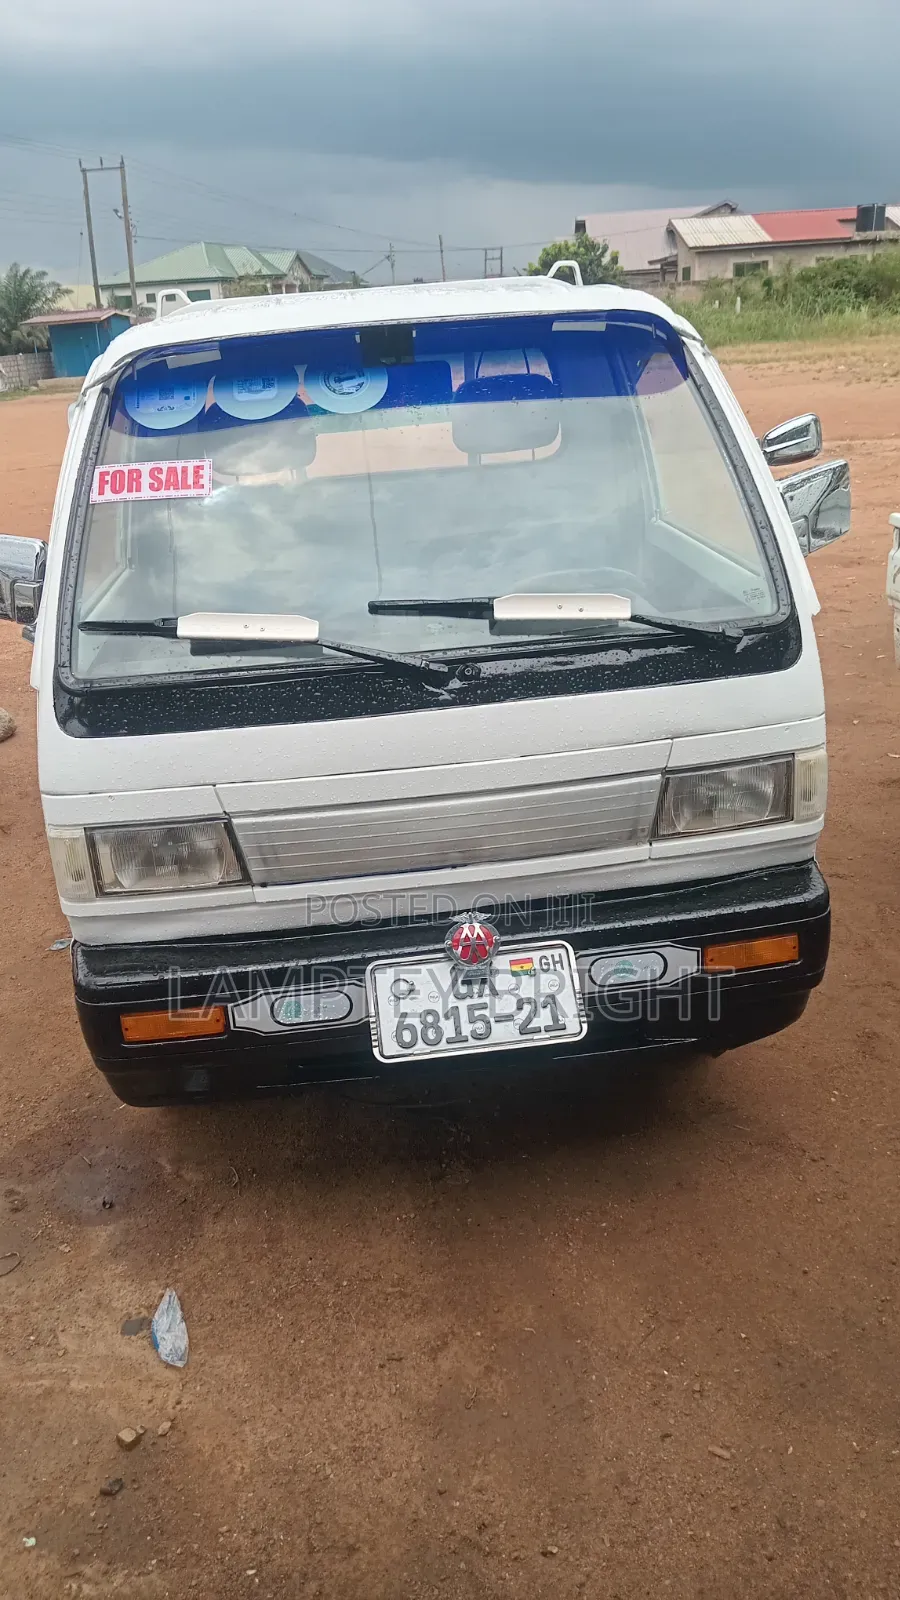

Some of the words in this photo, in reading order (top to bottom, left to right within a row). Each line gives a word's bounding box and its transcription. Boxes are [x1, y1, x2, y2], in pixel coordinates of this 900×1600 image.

[97, 468, 142, 496] FOR
[148, 464, 205, 492] SALE
[538, 953, 565, 973] GH
[395, 994, 567, 1049] 6815-21
